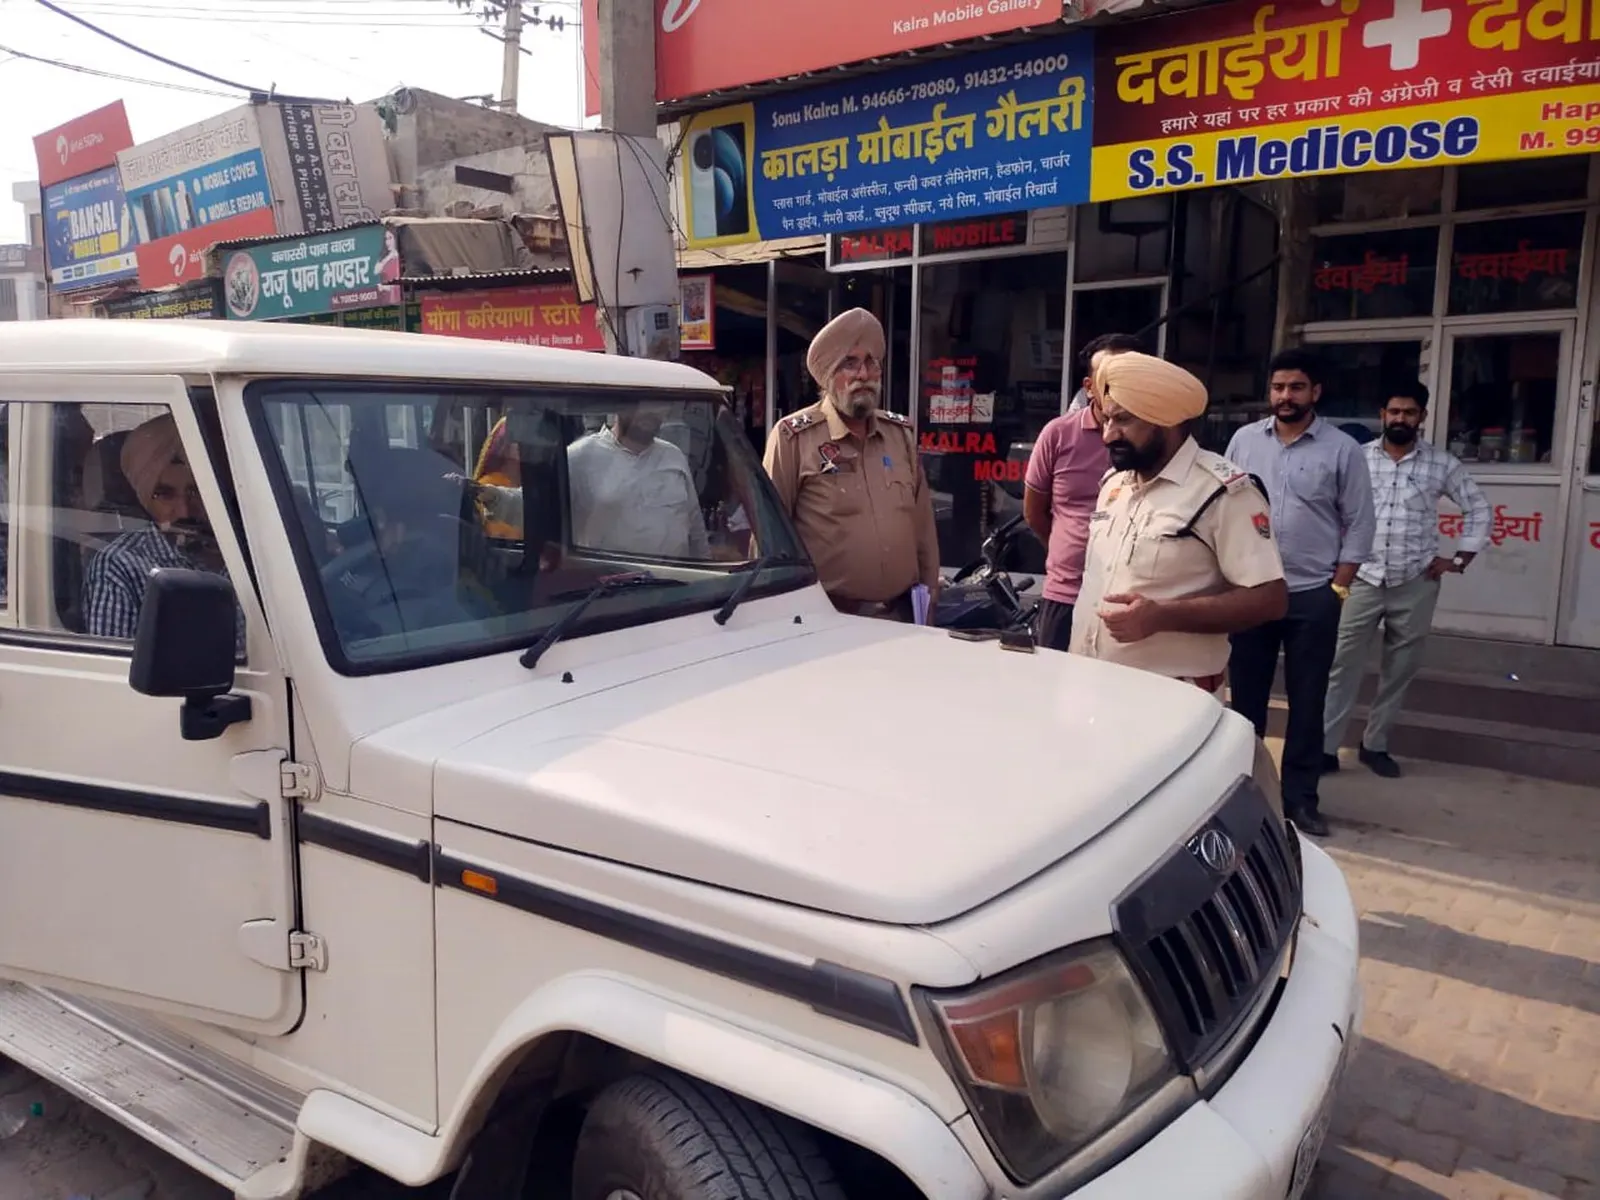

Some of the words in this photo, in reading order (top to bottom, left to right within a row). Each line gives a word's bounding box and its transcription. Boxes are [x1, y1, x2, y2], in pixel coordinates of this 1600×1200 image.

[893, 16, 929, 35] Kalra
[933, 4, 984, 26] Mobile
[772, 111, 801, 128] Sonu
[804, 103, 839, 121] Kalra
[842, 96, 858, 113] M.
[965, 54, 1068, 90] 91432-54000
[1161, 112, 1200, 134] हमारे
[1203, 106, 1232, 127] यहां
[1238, 107, 1261, 123] पर
[1265, 102, 1288, 121] हर
[1294, 95, 1343, 116] प्रकार
[1348, 86, 1374, 108] की
[1380, 76, 1440, 103] अंग्रेजी
[1447, 78, 1462, 95] व
[1470, 66, 1513, 91] देसी
[304, 124, 315, 150] Non
[761, 137, 849, 182] कालड़ा
[856, 103, 977, 165] मोबाईल
[985, 76, 1085, 142] गैलरी
[1519, 133, 1554, 150] M.
[921, 176, 942, 190] कवर
[1040, 150, 1071, 171] चार्जर
[1128, 143, 1205, 191] S.S.
[1215, 115, 1479, 182] Medicose
[202, 169, 230, 191] MOBILE
[230, 160, 258, 182] COVER
[297, 168, 312, 209] Picnic
[984, 184, 1022, 205] मोबाईल
[1025, 177, 1058, 198] रिचार्ज
[70, 200, 118, 240] BANSAL
[208, 199, 237, 220] MOBILE
[236, 191, 265, 213] REPAIR
[840, 231, 912, 259] KALRA
[934, 220, 1015, 248] MOBILE
[261, 268, 293, 309] राजू
[290, 264, 319, 293] पान
[322, 256, 371, 289] भण्डार
[465, 301, 535, 330] करियाणा
[540, 298, 582, 326] स्टोर
[921, 432, 997, 453] KALRA
[1438, 505, 1543, 546] दईयां
